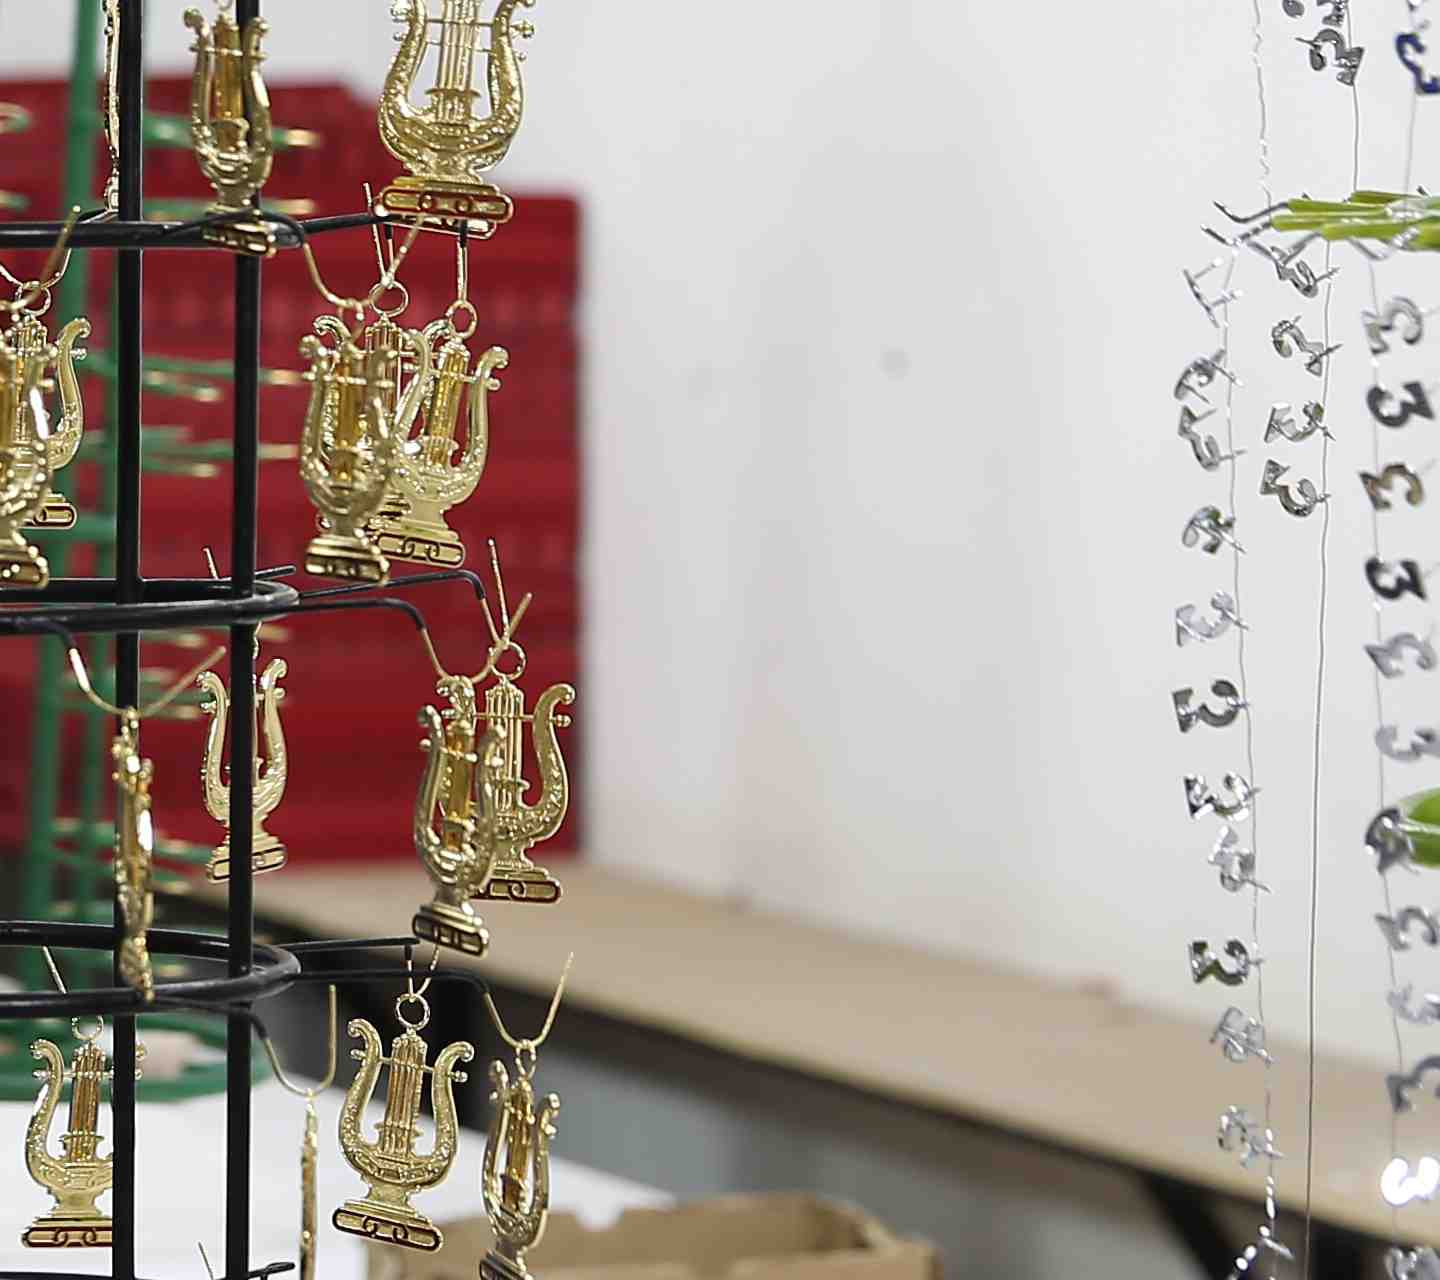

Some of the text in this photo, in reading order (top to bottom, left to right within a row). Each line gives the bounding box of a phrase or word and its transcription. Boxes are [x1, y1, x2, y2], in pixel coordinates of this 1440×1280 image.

[1367, 381, 1435, 428] 3
[1359, 463, 1425, 511] 3
[1364, 557, 1427, 601] 3
[1364, 632, 1438, 679] 3
